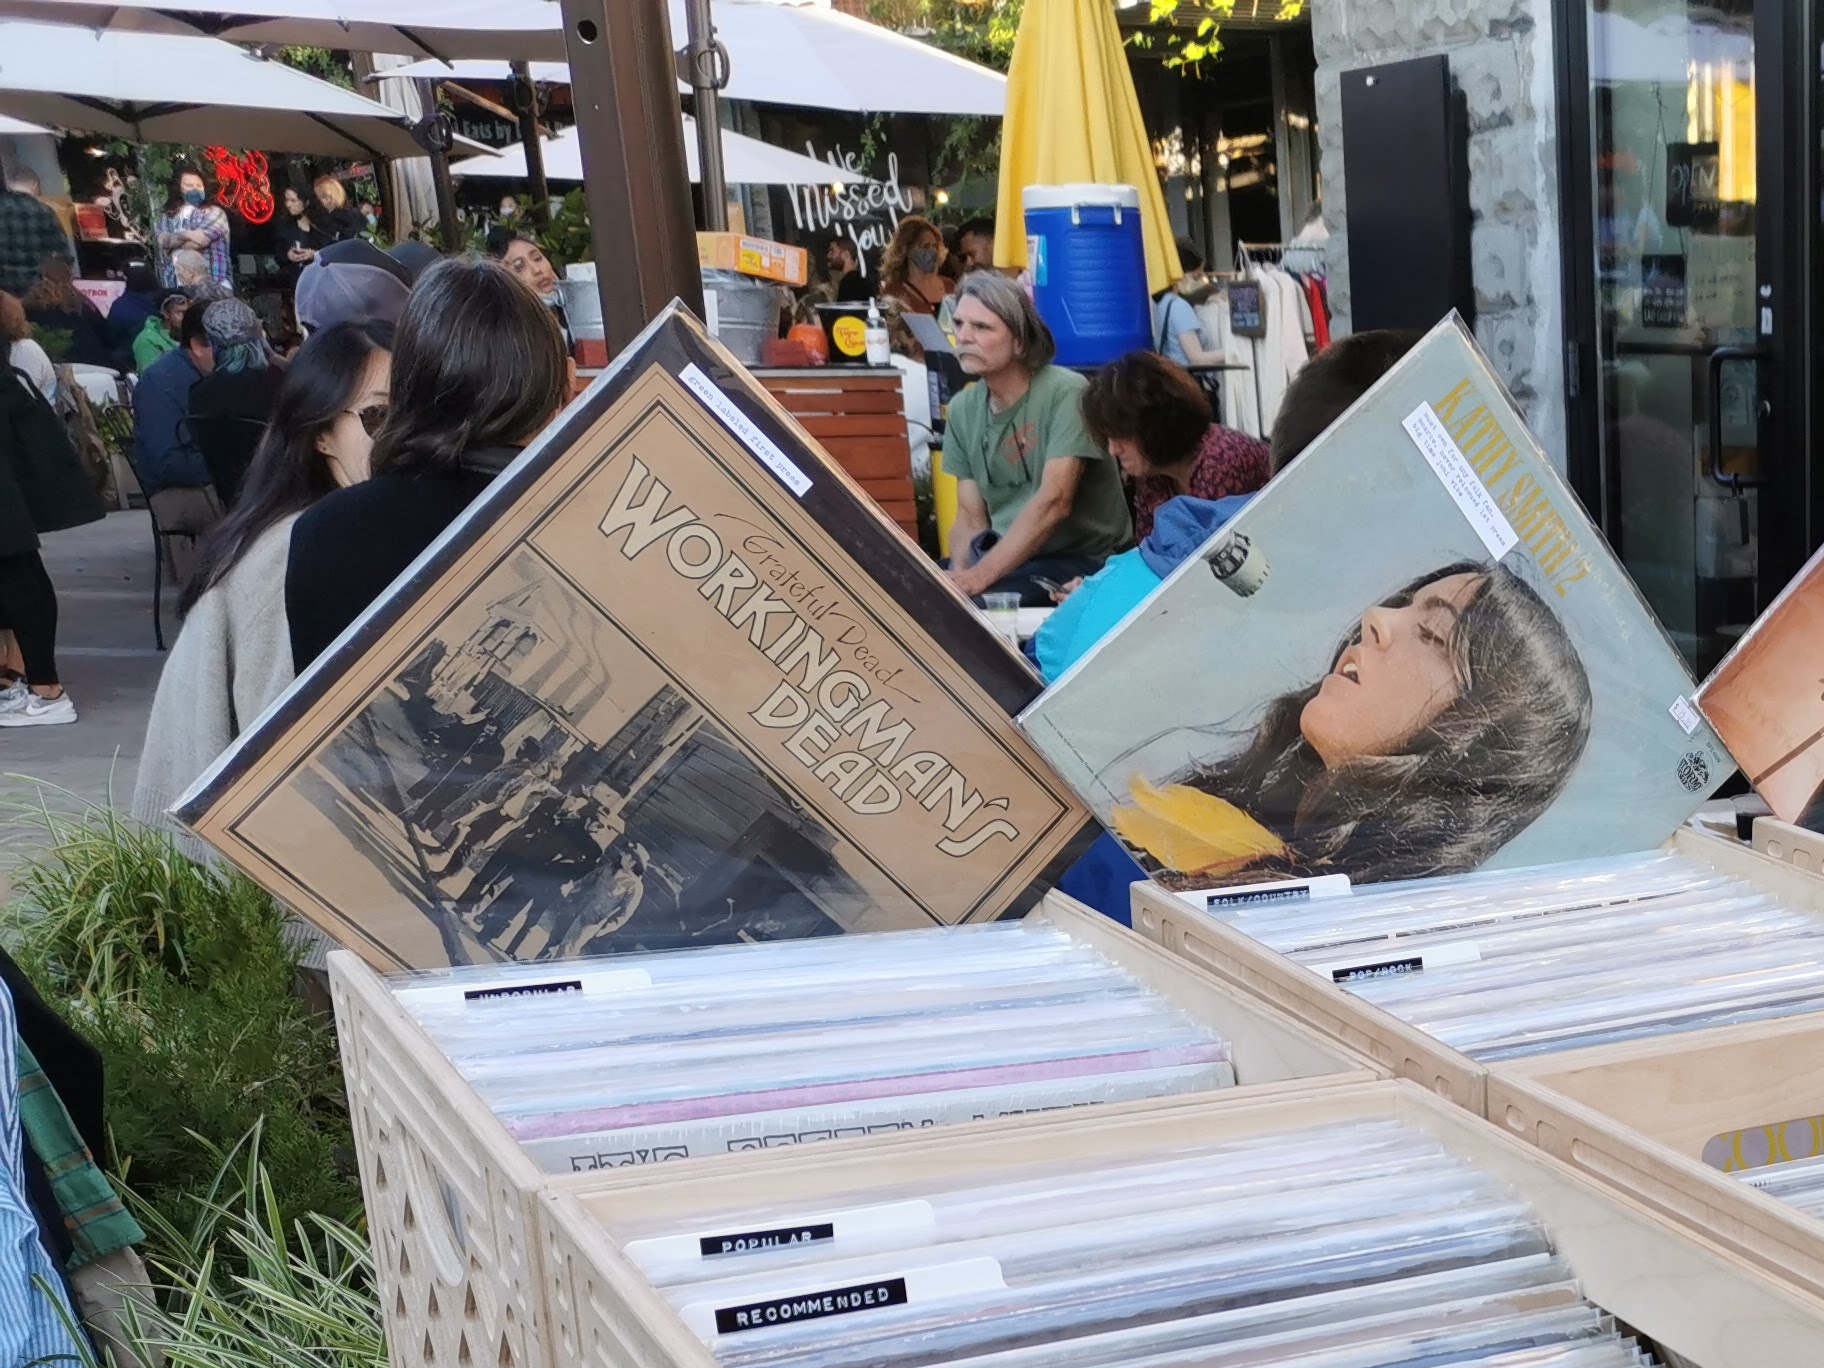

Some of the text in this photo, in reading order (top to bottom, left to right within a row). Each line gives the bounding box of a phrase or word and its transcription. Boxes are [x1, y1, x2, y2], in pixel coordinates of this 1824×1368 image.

[687, 374, 801, 487] green labeled first press
[1434, 378, 1524, 488] KATHY
[1438, 450, 1456, 471] never
[1456, 464, 1469, 479] any
[1467, 480, 1484, 498] folk
[598, 453, 1020, 858] WORKINGMAN'S
[714, 513, 920, 703] Grateful Dead
[749, 679, 901, 815] DEAD
[721, 1230, 812, 1254] POPULAR
[735, 1286, 889, 1327] RECOMMENDED
